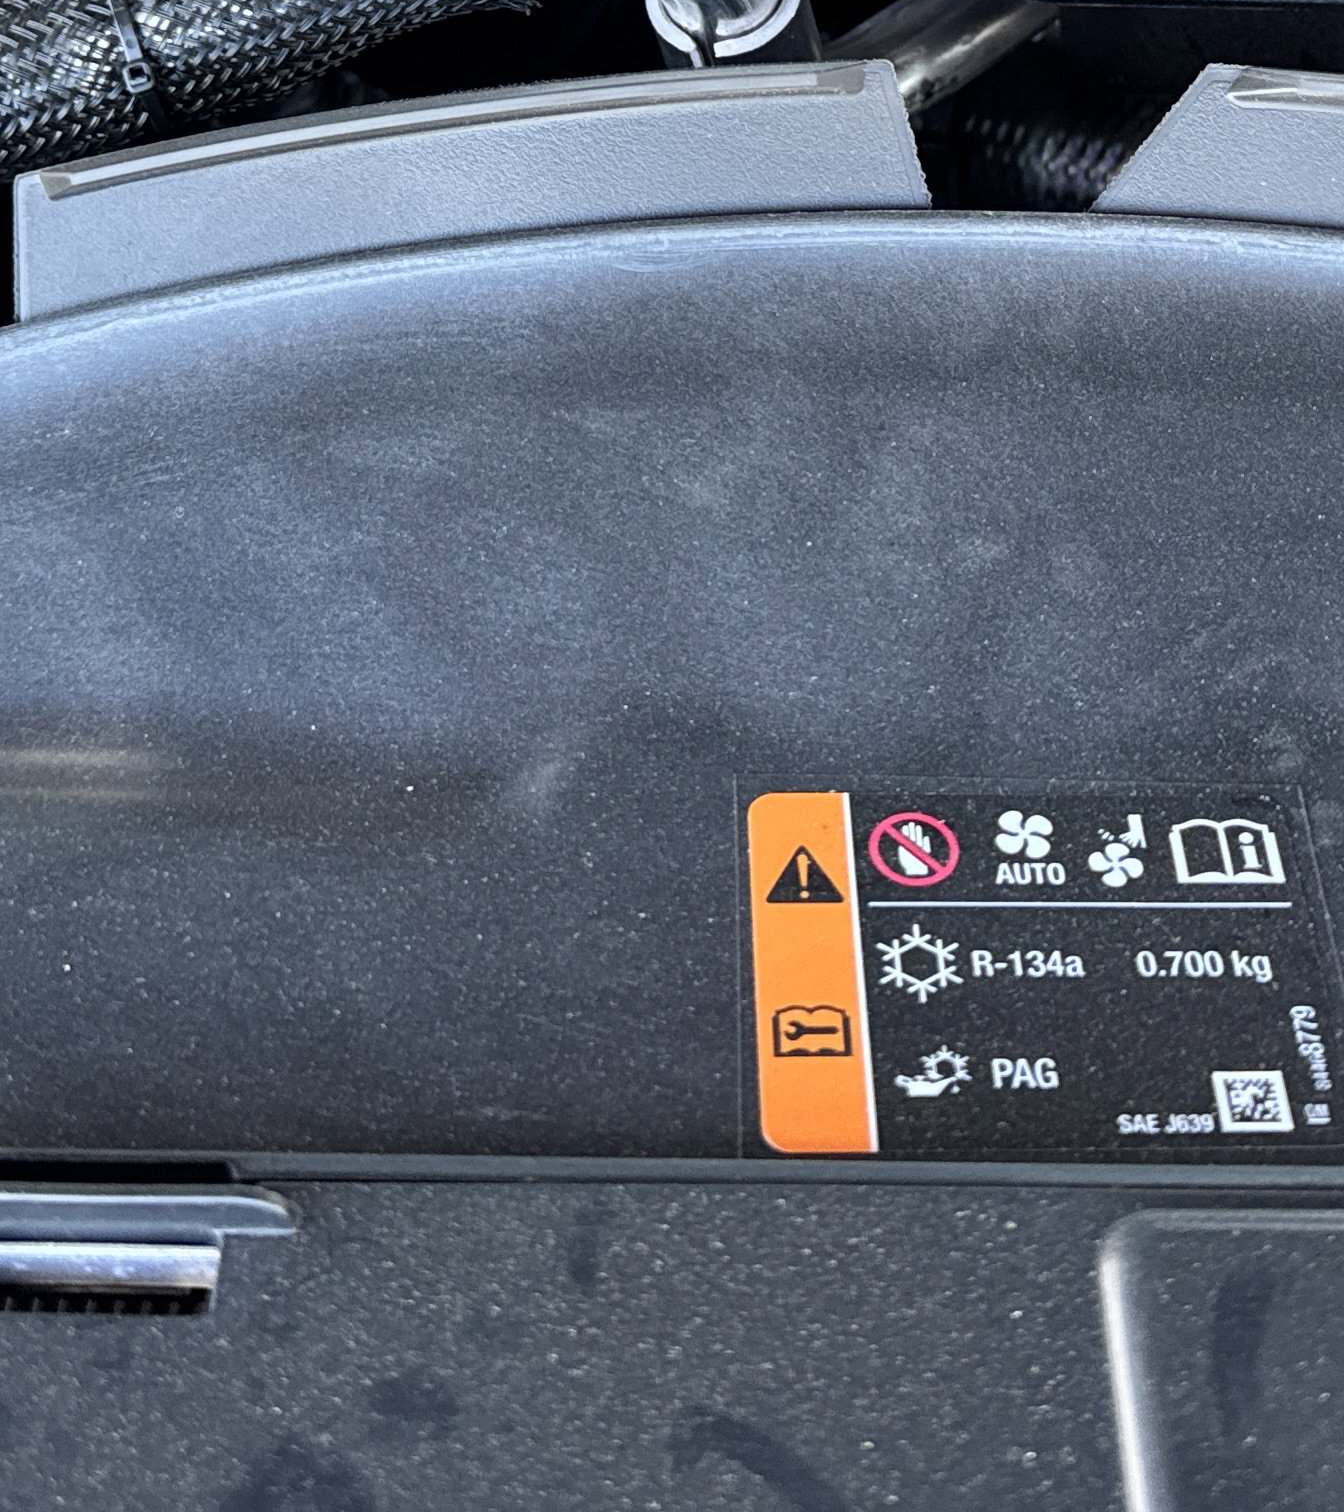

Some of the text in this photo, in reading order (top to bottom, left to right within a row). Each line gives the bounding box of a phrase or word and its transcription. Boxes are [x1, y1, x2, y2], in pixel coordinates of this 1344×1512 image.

[995, 862, 1066, 887] AUTO
[971, 950, 1273, 983] R-134a 0.700 kg
[992, 1058, 1059, 1090] PAG
[1117, 1113, 1215, 1134] SAE J639
